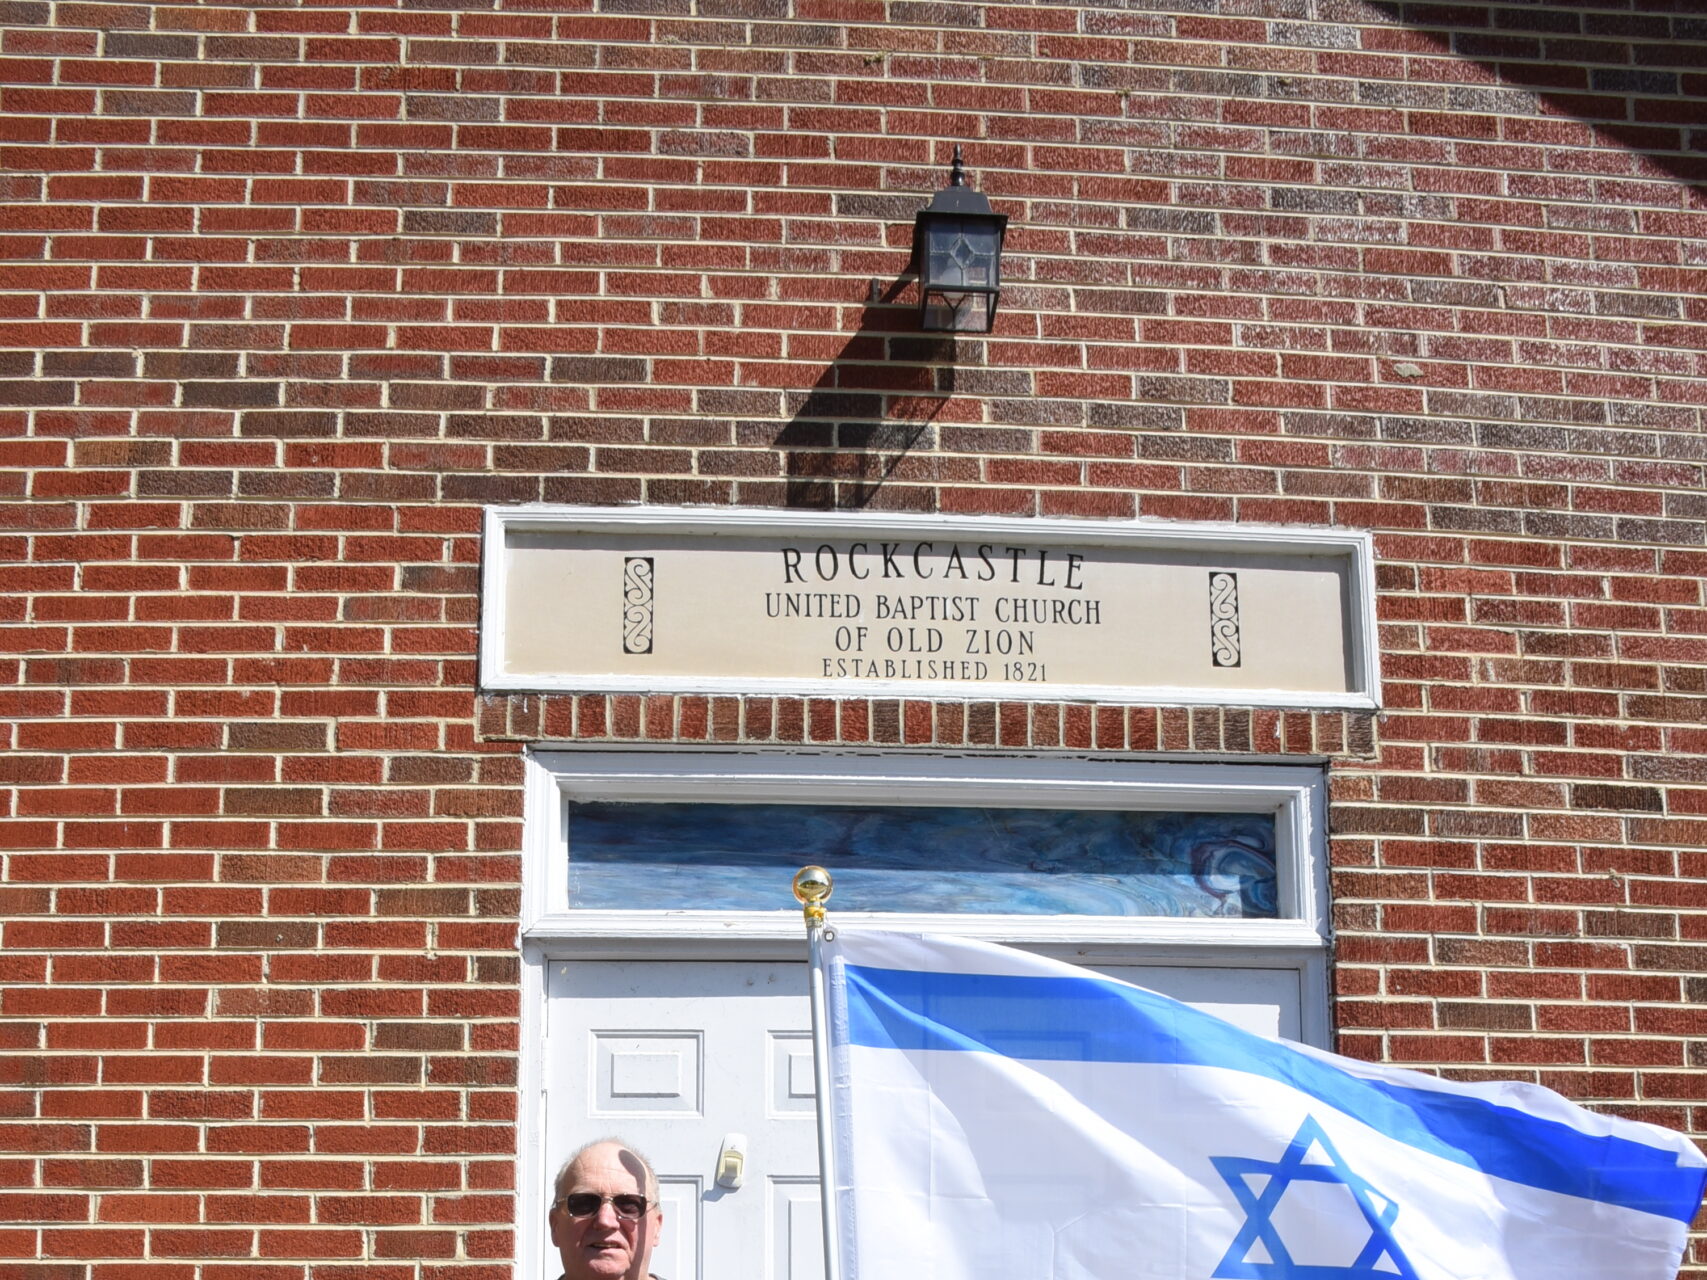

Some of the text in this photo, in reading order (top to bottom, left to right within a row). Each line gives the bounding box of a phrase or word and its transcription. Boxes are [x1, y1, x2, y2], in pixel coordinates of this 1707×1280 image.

[781, 541, 1084, 590] ROCKCASTLE
[765, 592, 1101, 625] UNITED BAPTIST CHURCH
[835, 626, 1034, 656] OF OLD ZION
[823, 658, 1047, 682] ESTABLISHED 1821
